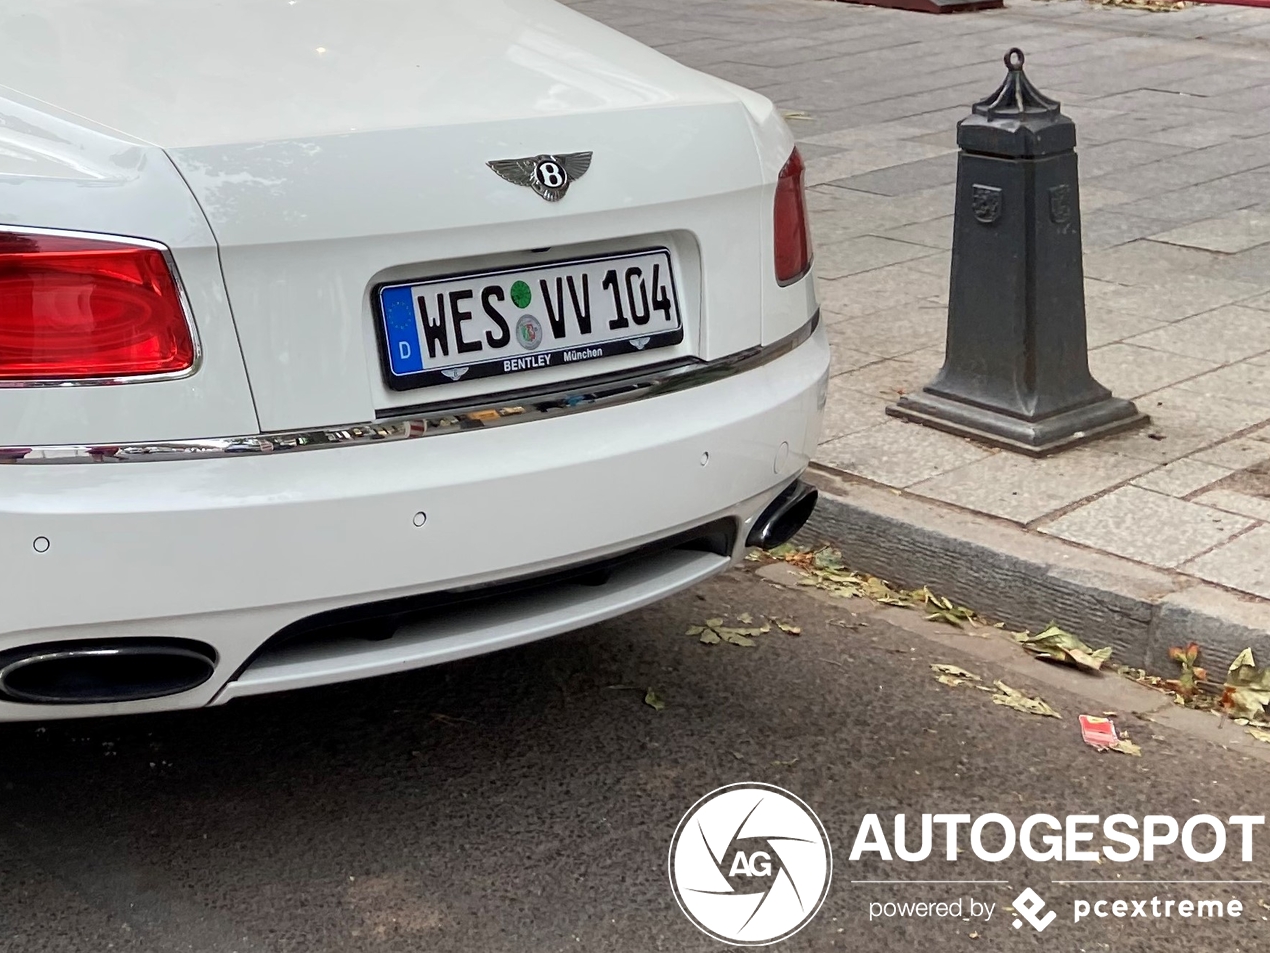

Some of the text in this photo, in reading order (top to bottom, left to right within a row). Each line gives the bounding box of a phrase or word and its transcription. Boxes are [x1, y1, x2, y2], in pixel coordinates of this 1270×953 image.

[398, 263, 672, 360] D WES VV 104
[503, 347, 603, 372] BENTLEY München
